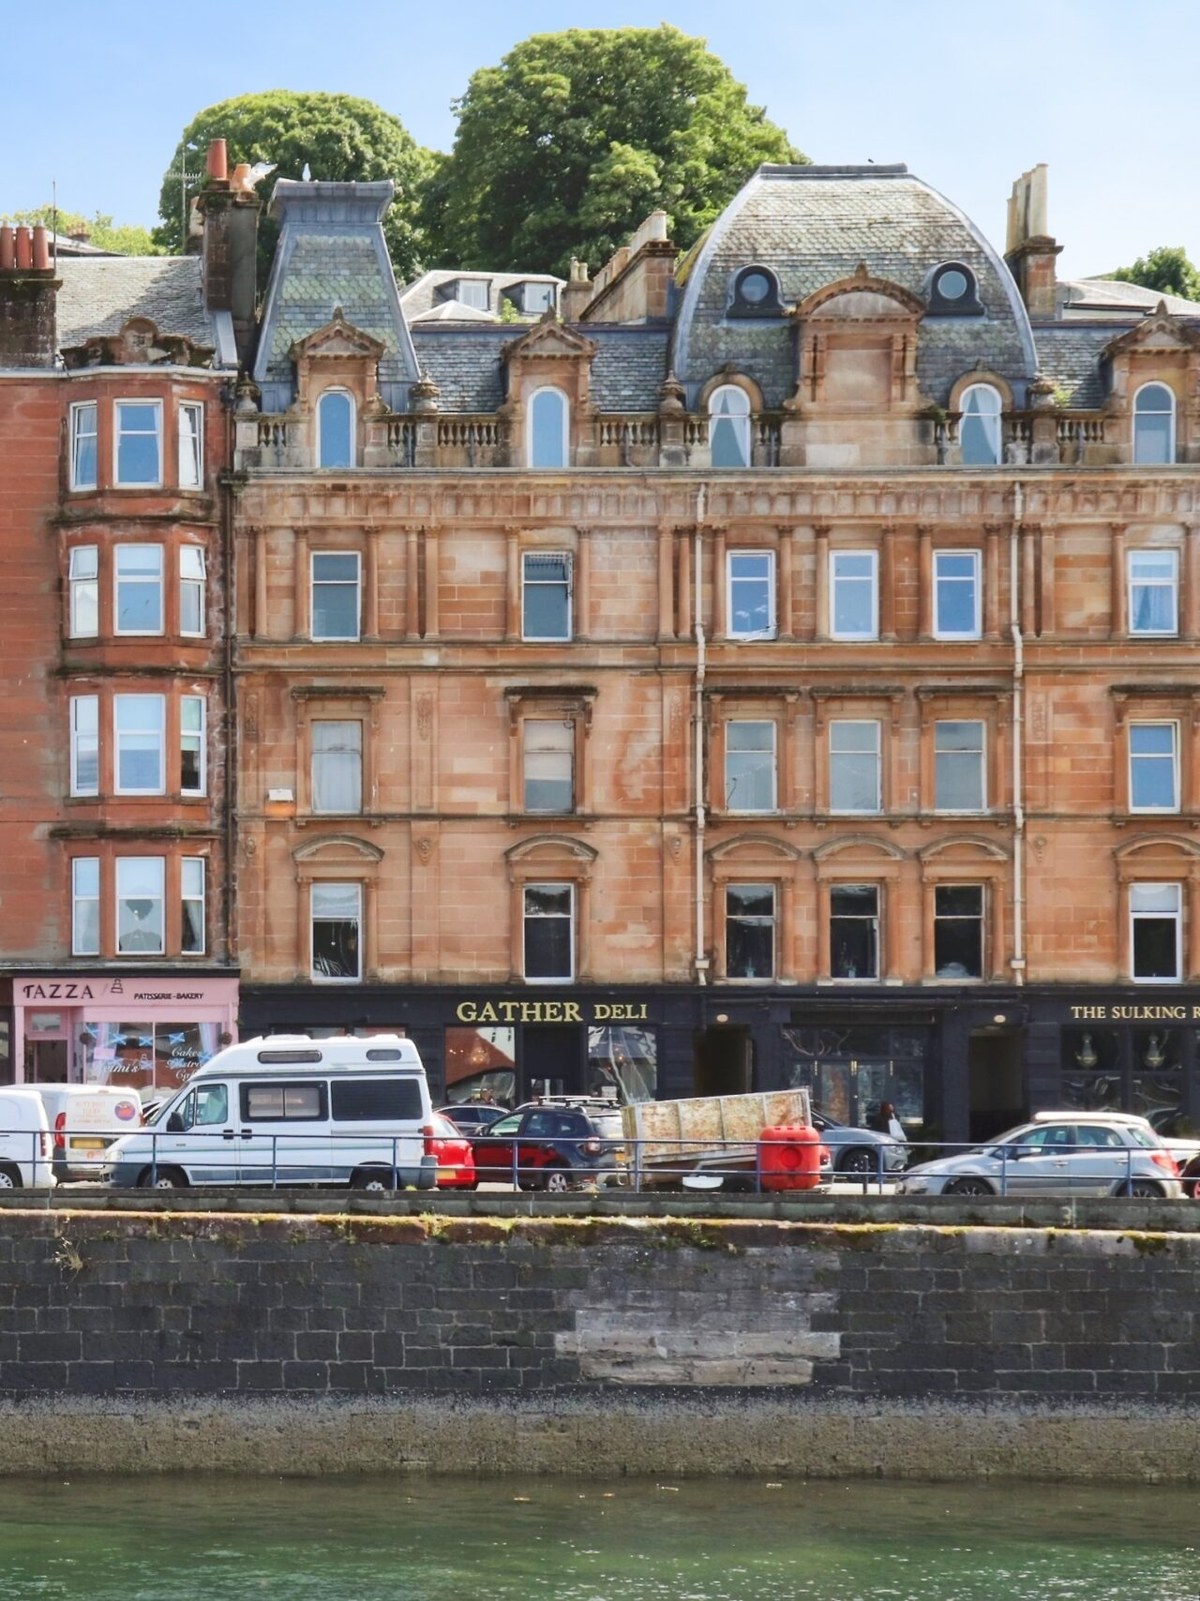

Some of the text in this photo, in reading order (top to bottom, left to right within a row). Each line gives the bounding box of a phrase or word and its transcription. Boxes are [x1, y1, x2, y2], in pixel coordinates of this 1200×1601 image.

[23, 984, 94, 999] TAZZA
[456, 1001, 647, 1022] GATHER DELI
[1070, 1006, 1106, 1019] THE
[1111, 1006, 1187, 1019] SULKING
